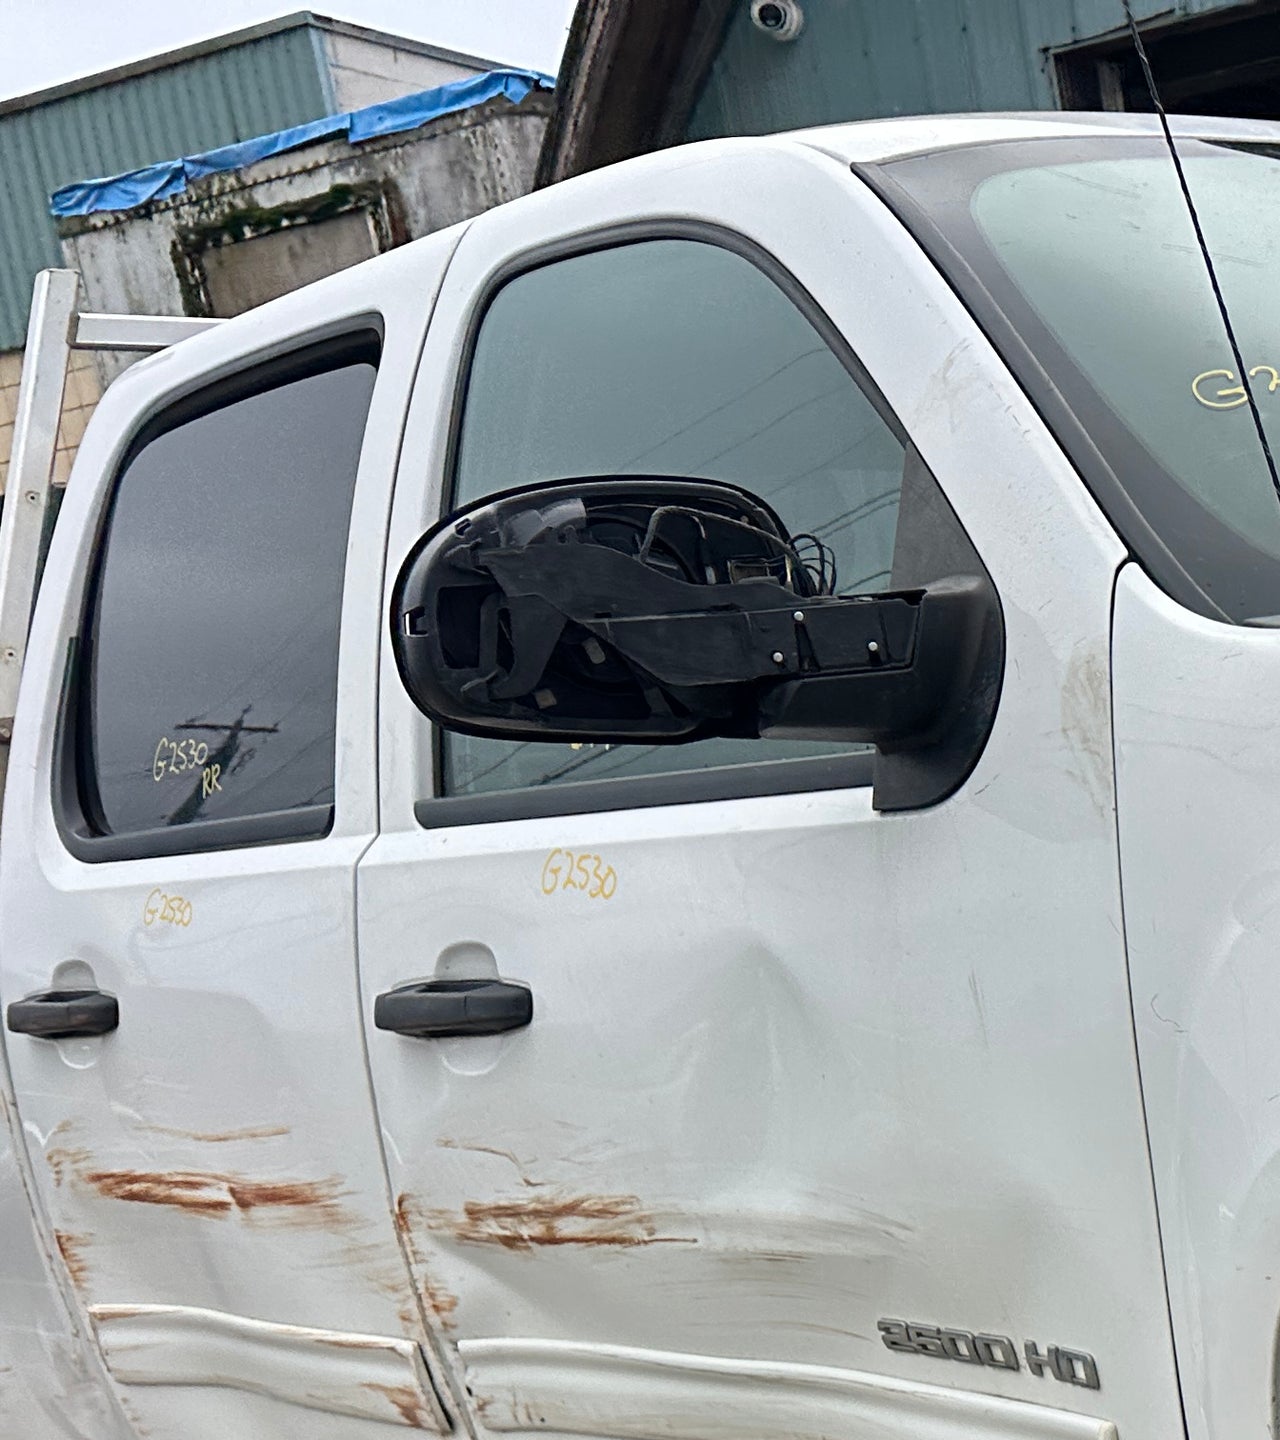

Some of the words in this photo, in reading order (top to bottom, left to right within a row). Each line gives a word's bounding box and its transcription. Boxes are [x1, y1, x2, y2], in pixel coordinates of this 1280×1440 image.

[153, 737, 209, 781] G2530
[202, 763, 223, 799] RR
[541, 847, 618, 900] G2530
[144, 887, 193, 927] G2530
[877, 1316, 1020, 1371] 2500
[1024, 1339, 1101, 1390] HD
